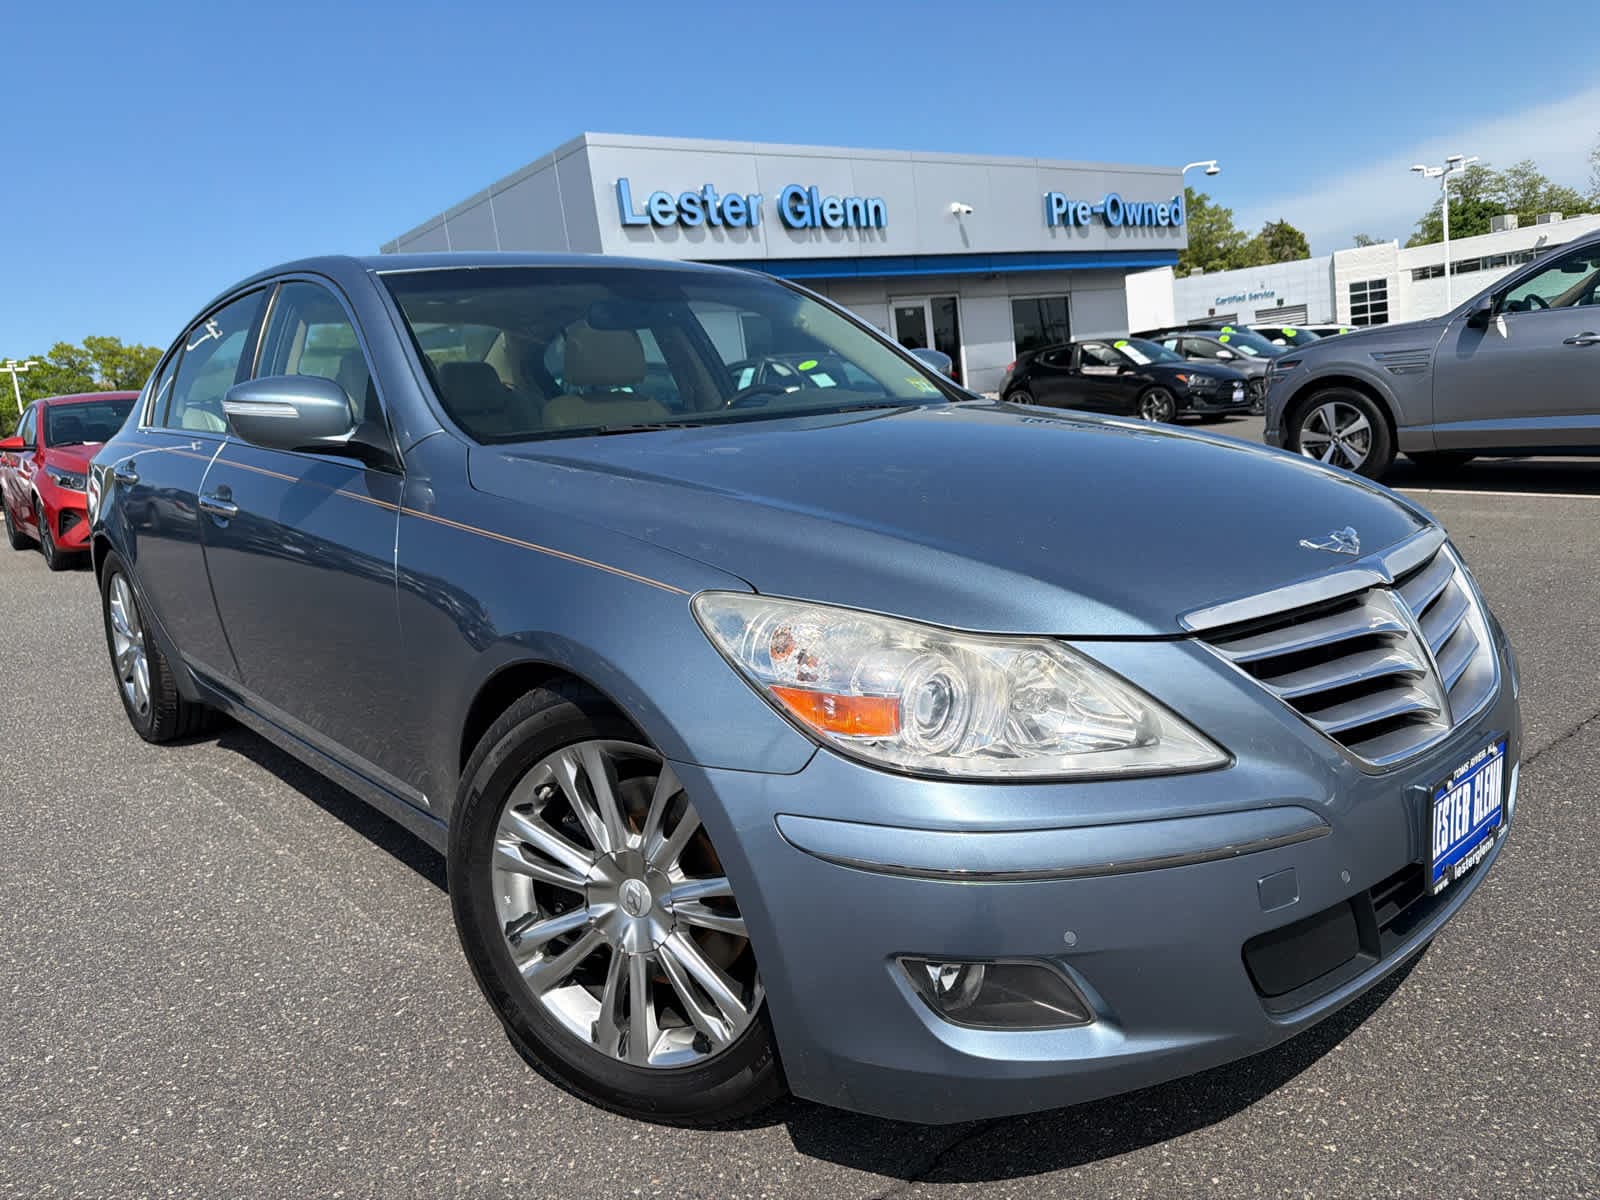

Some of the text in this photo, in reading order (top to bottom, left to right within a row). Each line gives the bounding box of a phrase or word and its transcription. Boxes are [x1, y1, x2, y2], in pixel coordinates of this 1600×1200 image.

[616, 177, 887, 229] Lester Glenn
[1045, 192, 1184, 227] Pre-Owned
[1248, 290, 1275, 301] Service
[1433, 781, 1471, 861] LESTER
